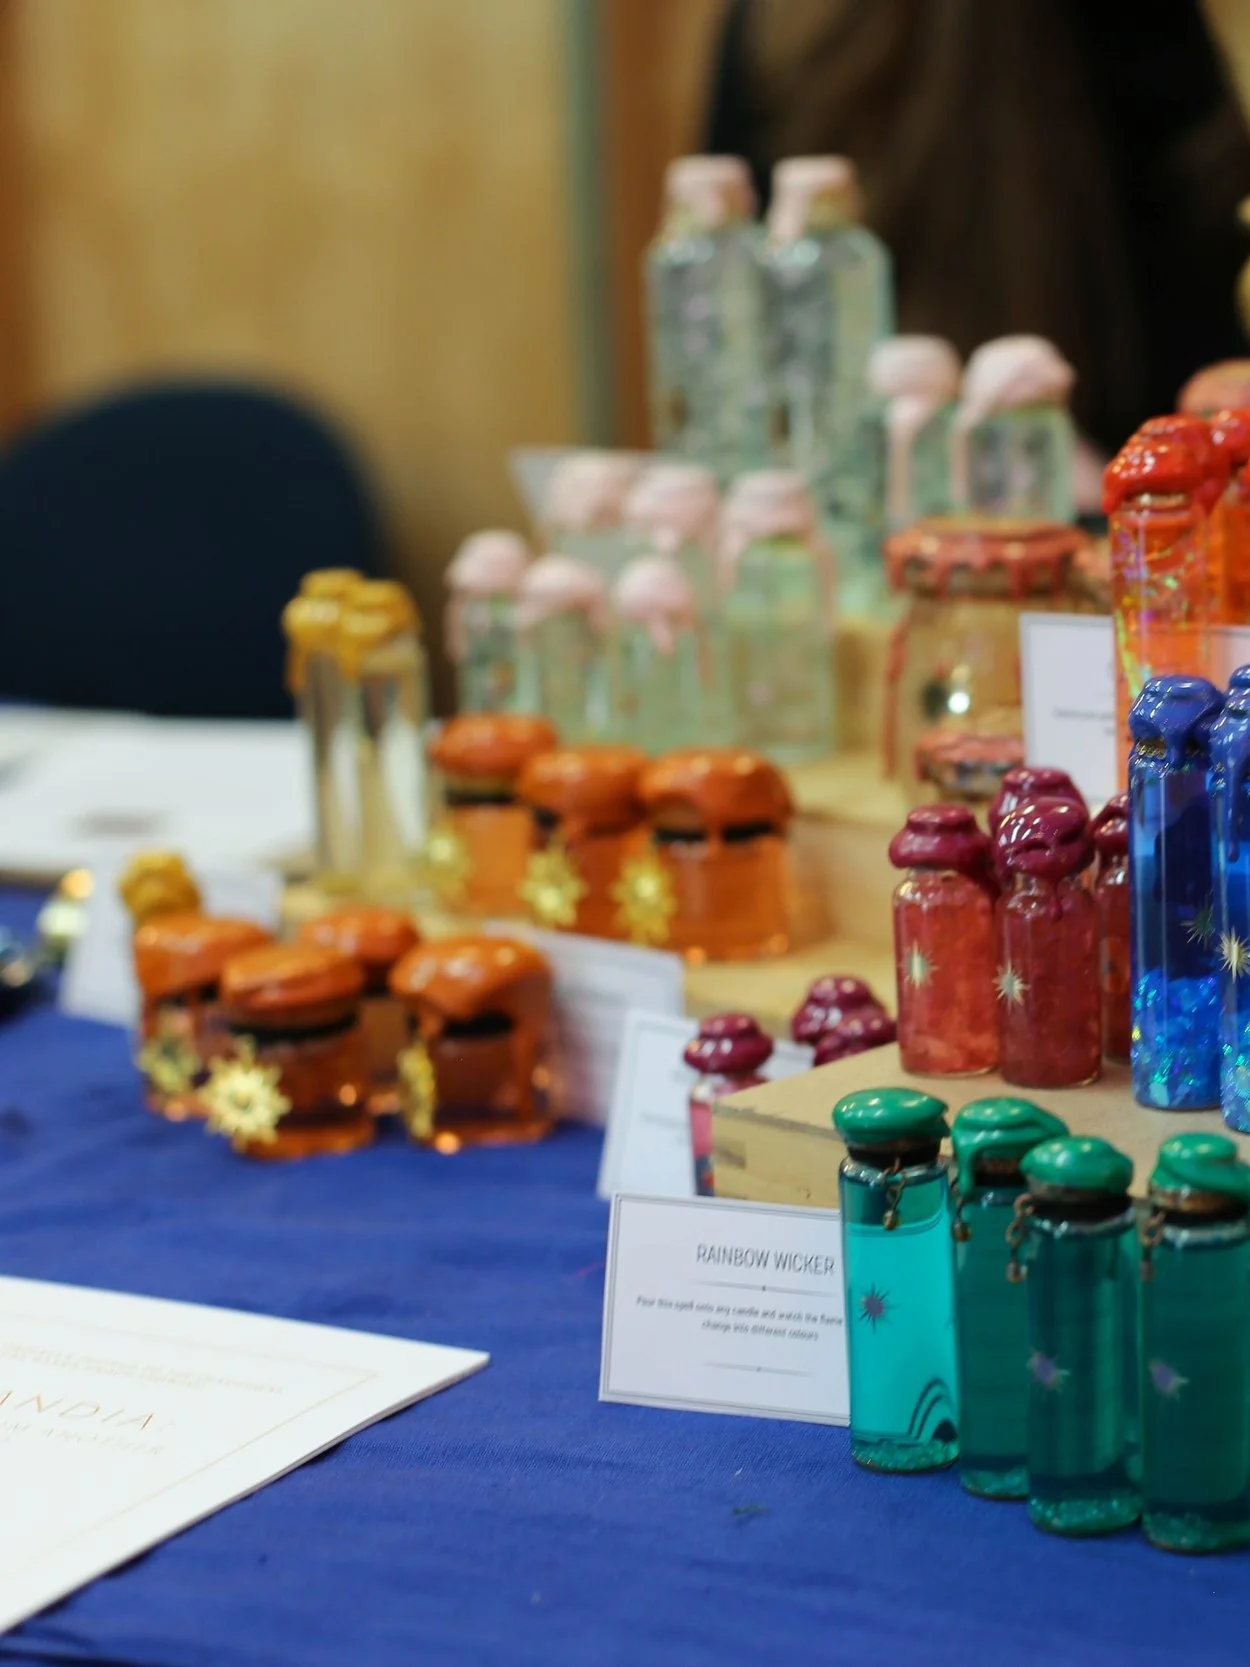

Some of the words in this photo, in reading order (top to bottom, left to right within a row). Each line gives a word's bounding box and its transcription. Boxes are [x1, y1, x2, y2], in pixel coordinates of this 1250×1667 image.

[697, 1244, 770, 1269] RAINBOW
[774, 1250, 836, 1276] WICKER
[637, 1295, 655, 1307] Pour
[657, 1298, 673, 1309] this
[674, 1300, 694, 1312] spell
[695, 1302, 714, 1313] onto
[715, 1306, 731, 1317] any
[731, 1306, 759, 1318] candle
[760, 1309, 776, 1320] and
[778, 1310, 803, 1322] watch
[804, 1312, 818, 1323] the
[819, 1313, 843, 1326] flame
[702, 1319, 731, 1333] change
[732, 1322, 749, 1334] into
[750, 1323, 787, 1337] different
[788, 1328, 819, 1341] colours
